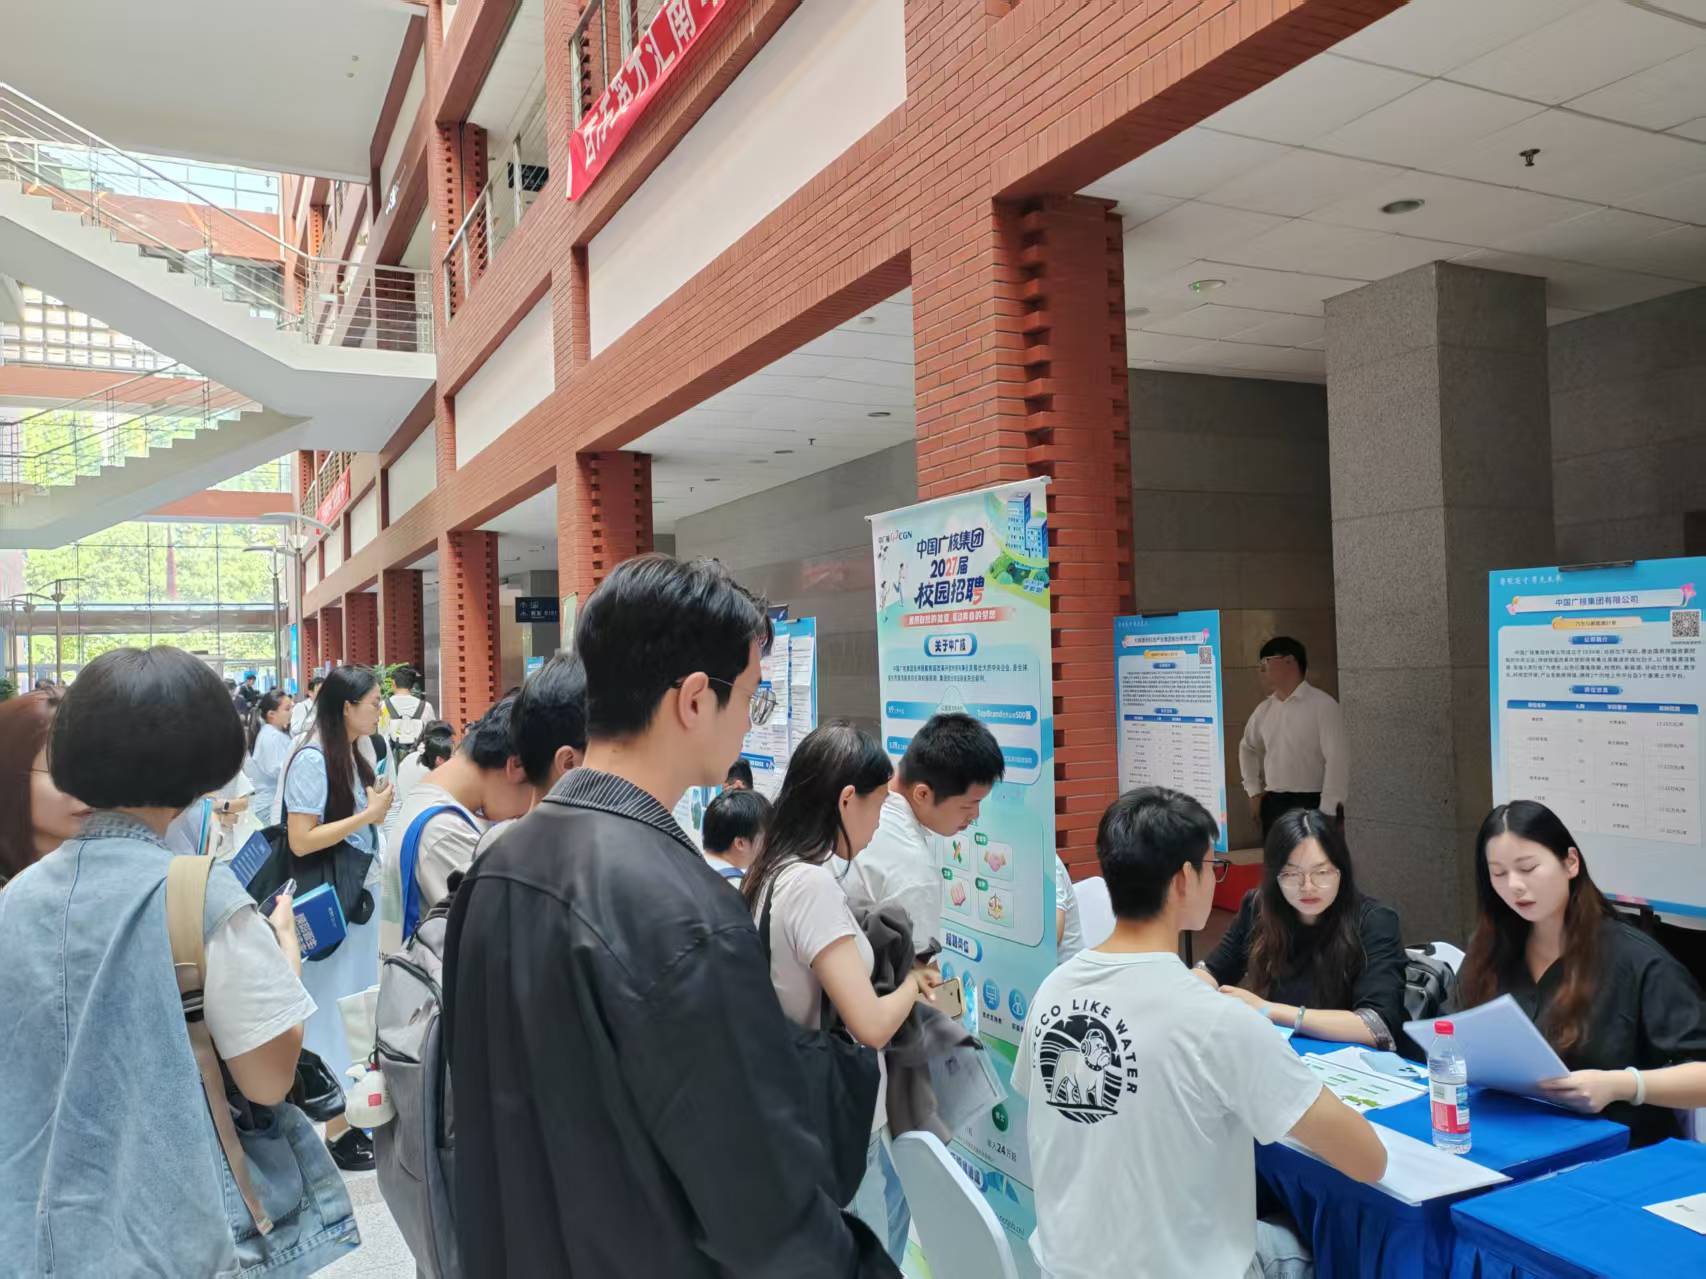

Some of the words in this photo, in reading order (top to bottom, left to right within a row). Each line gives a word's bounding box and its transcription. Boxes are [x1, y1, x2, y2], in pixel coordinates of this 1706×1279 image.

[916, 528, 985, 559] 中国广核集团
[930, 556, 969, 579] 2027届
[914, 576, 985, 609] 校园招聘
[1555, 595, 1639, 606] 中国广核集团有限公司
[935, 639, 966, 653] 关于中广核
[1073, 1000, 1111, 1019] LIKE
[1115, 1019, 1138, 1094] WATER
